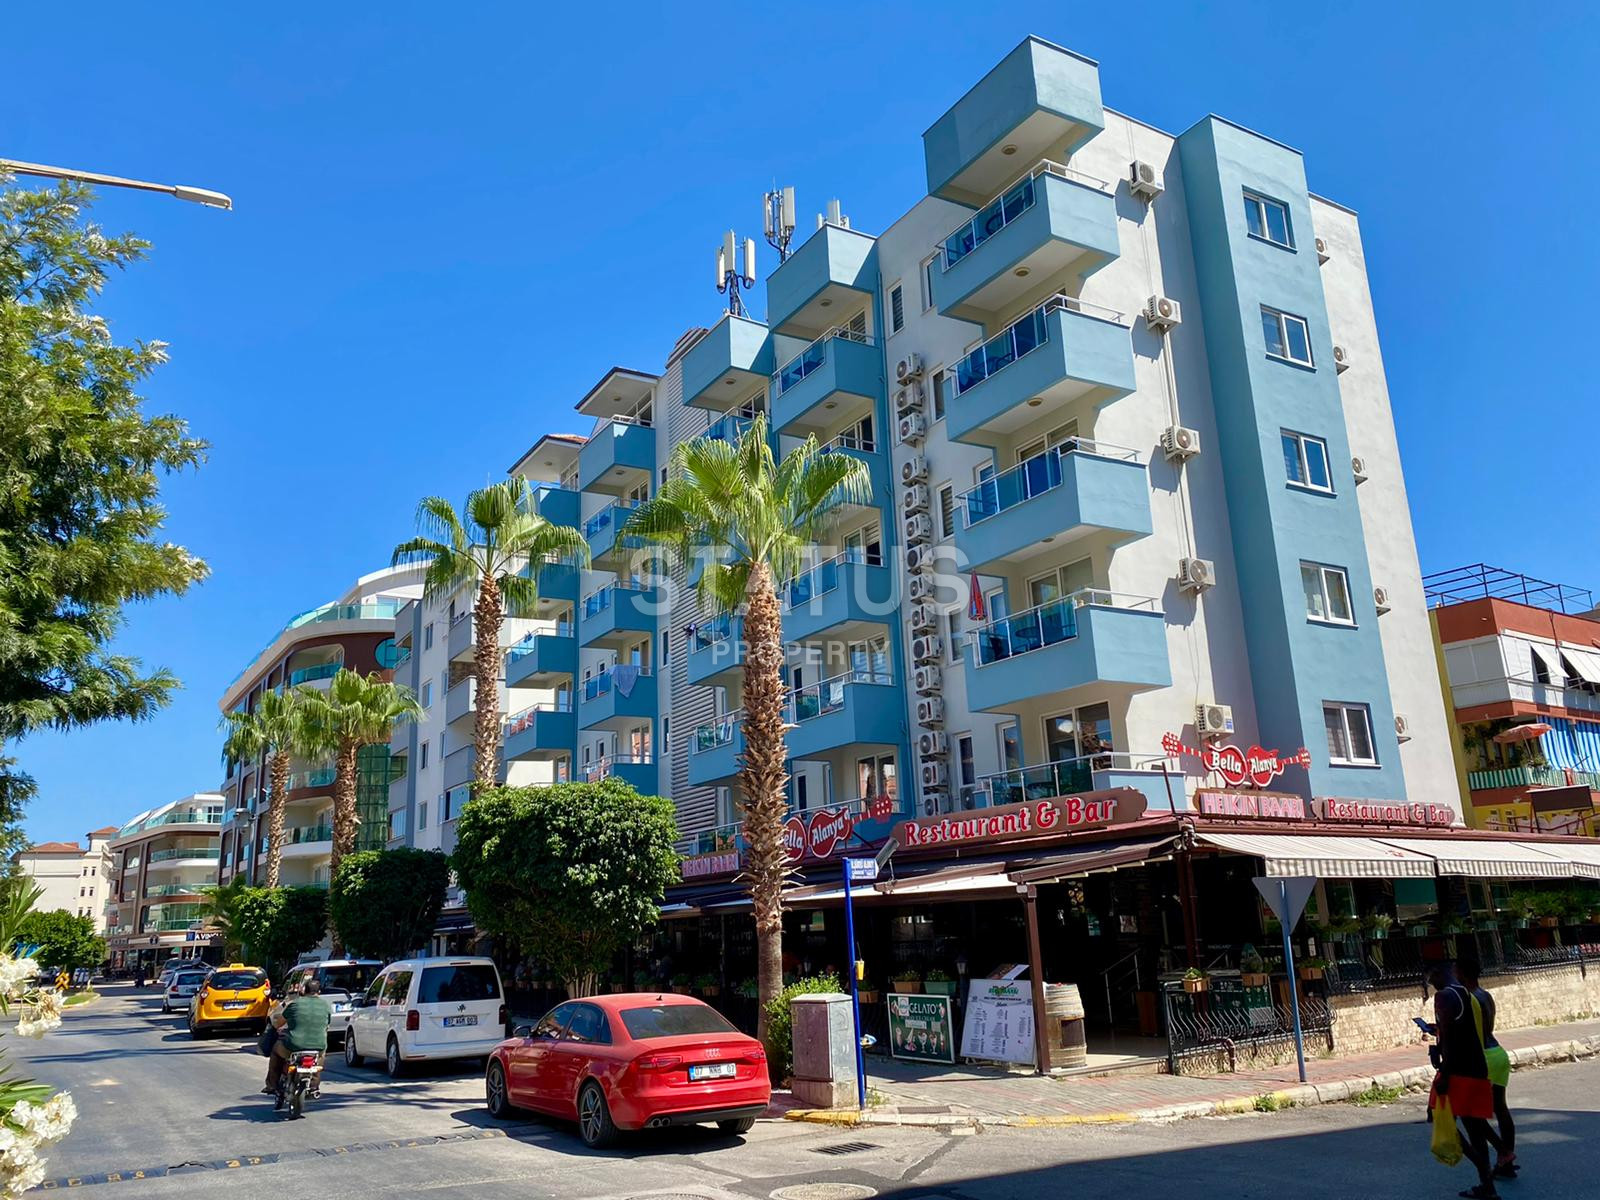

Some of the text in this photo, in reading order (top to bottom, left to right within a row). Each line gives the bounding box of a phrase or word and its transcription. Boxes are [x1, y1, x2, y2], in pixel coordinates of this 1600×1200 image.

[1212, 750, 1278, 774] Bella Alanya
[904, 797, 1117, 846] Restaurant & Bar
[1326, 798, 1453, 823] Restaurant & Bar
[783, 816, 844, 848] ella Alanya
[909, 1002, 937, 1015] GELATO
